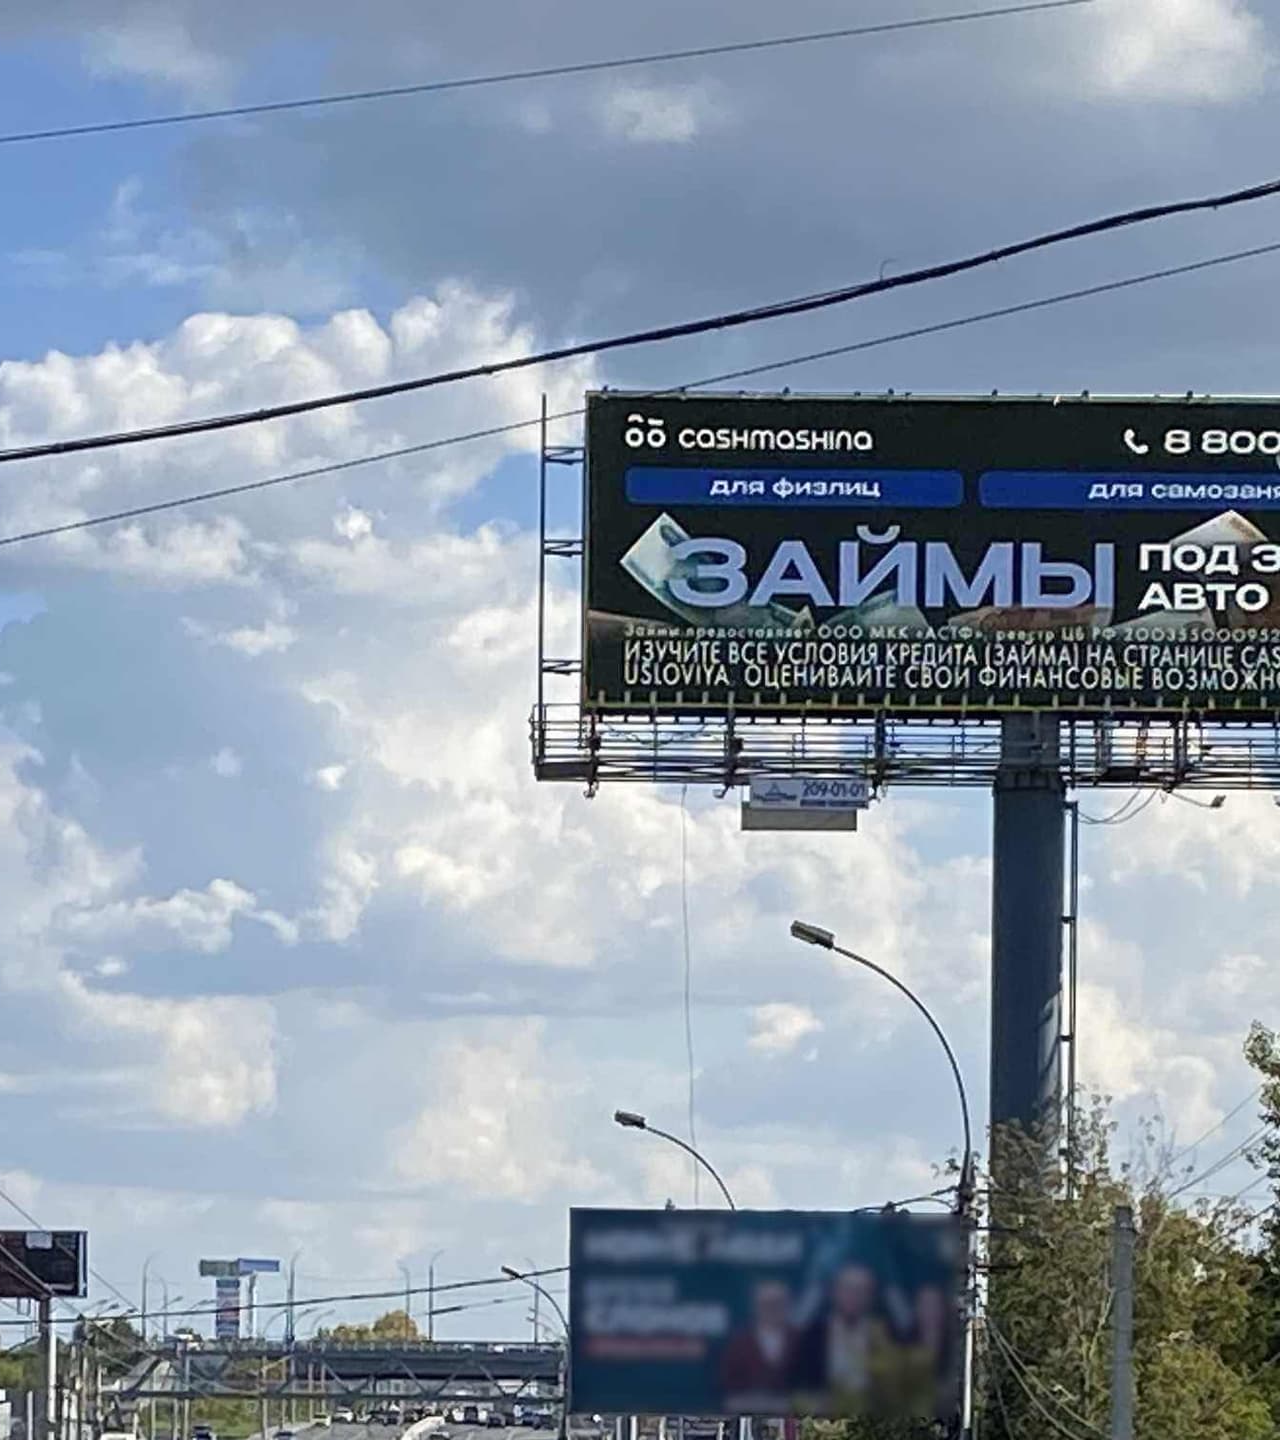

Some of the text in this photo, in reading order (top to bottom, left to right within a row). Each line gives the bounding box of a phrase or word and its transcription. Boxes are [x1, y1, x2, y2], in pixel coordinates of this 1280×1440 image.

[1163, 429, 1193, 455] 8
[708, 477, 882, 499] для физлиц
[1087, 482, 1144, 500] для
[668, 524, 1116, 609] ЗАЙМЫ
[1139, 543, 1239, 576] ПОД
[1137, 582, 1270, 612] АВТО
[817, 624, 864, 641] ООО
[870, 626, 909, 640] МКК
[1092, 627, 1117, 642] РФ
[624, 640, 721, 664] ИЗУЧИТЕ
[728, 641, 769, 665] ВСЕ
[774, 642, 878, 665] УСЛОВИЯ
[885, 643, 978, 668] КРЕДИТА
[1086, 644, 1117, 668] НА
[1123, 645, 1234, 669] СТРАНИЦЕ
[978, 664, 1144, 691] ФИНАНСОВЫЕ
